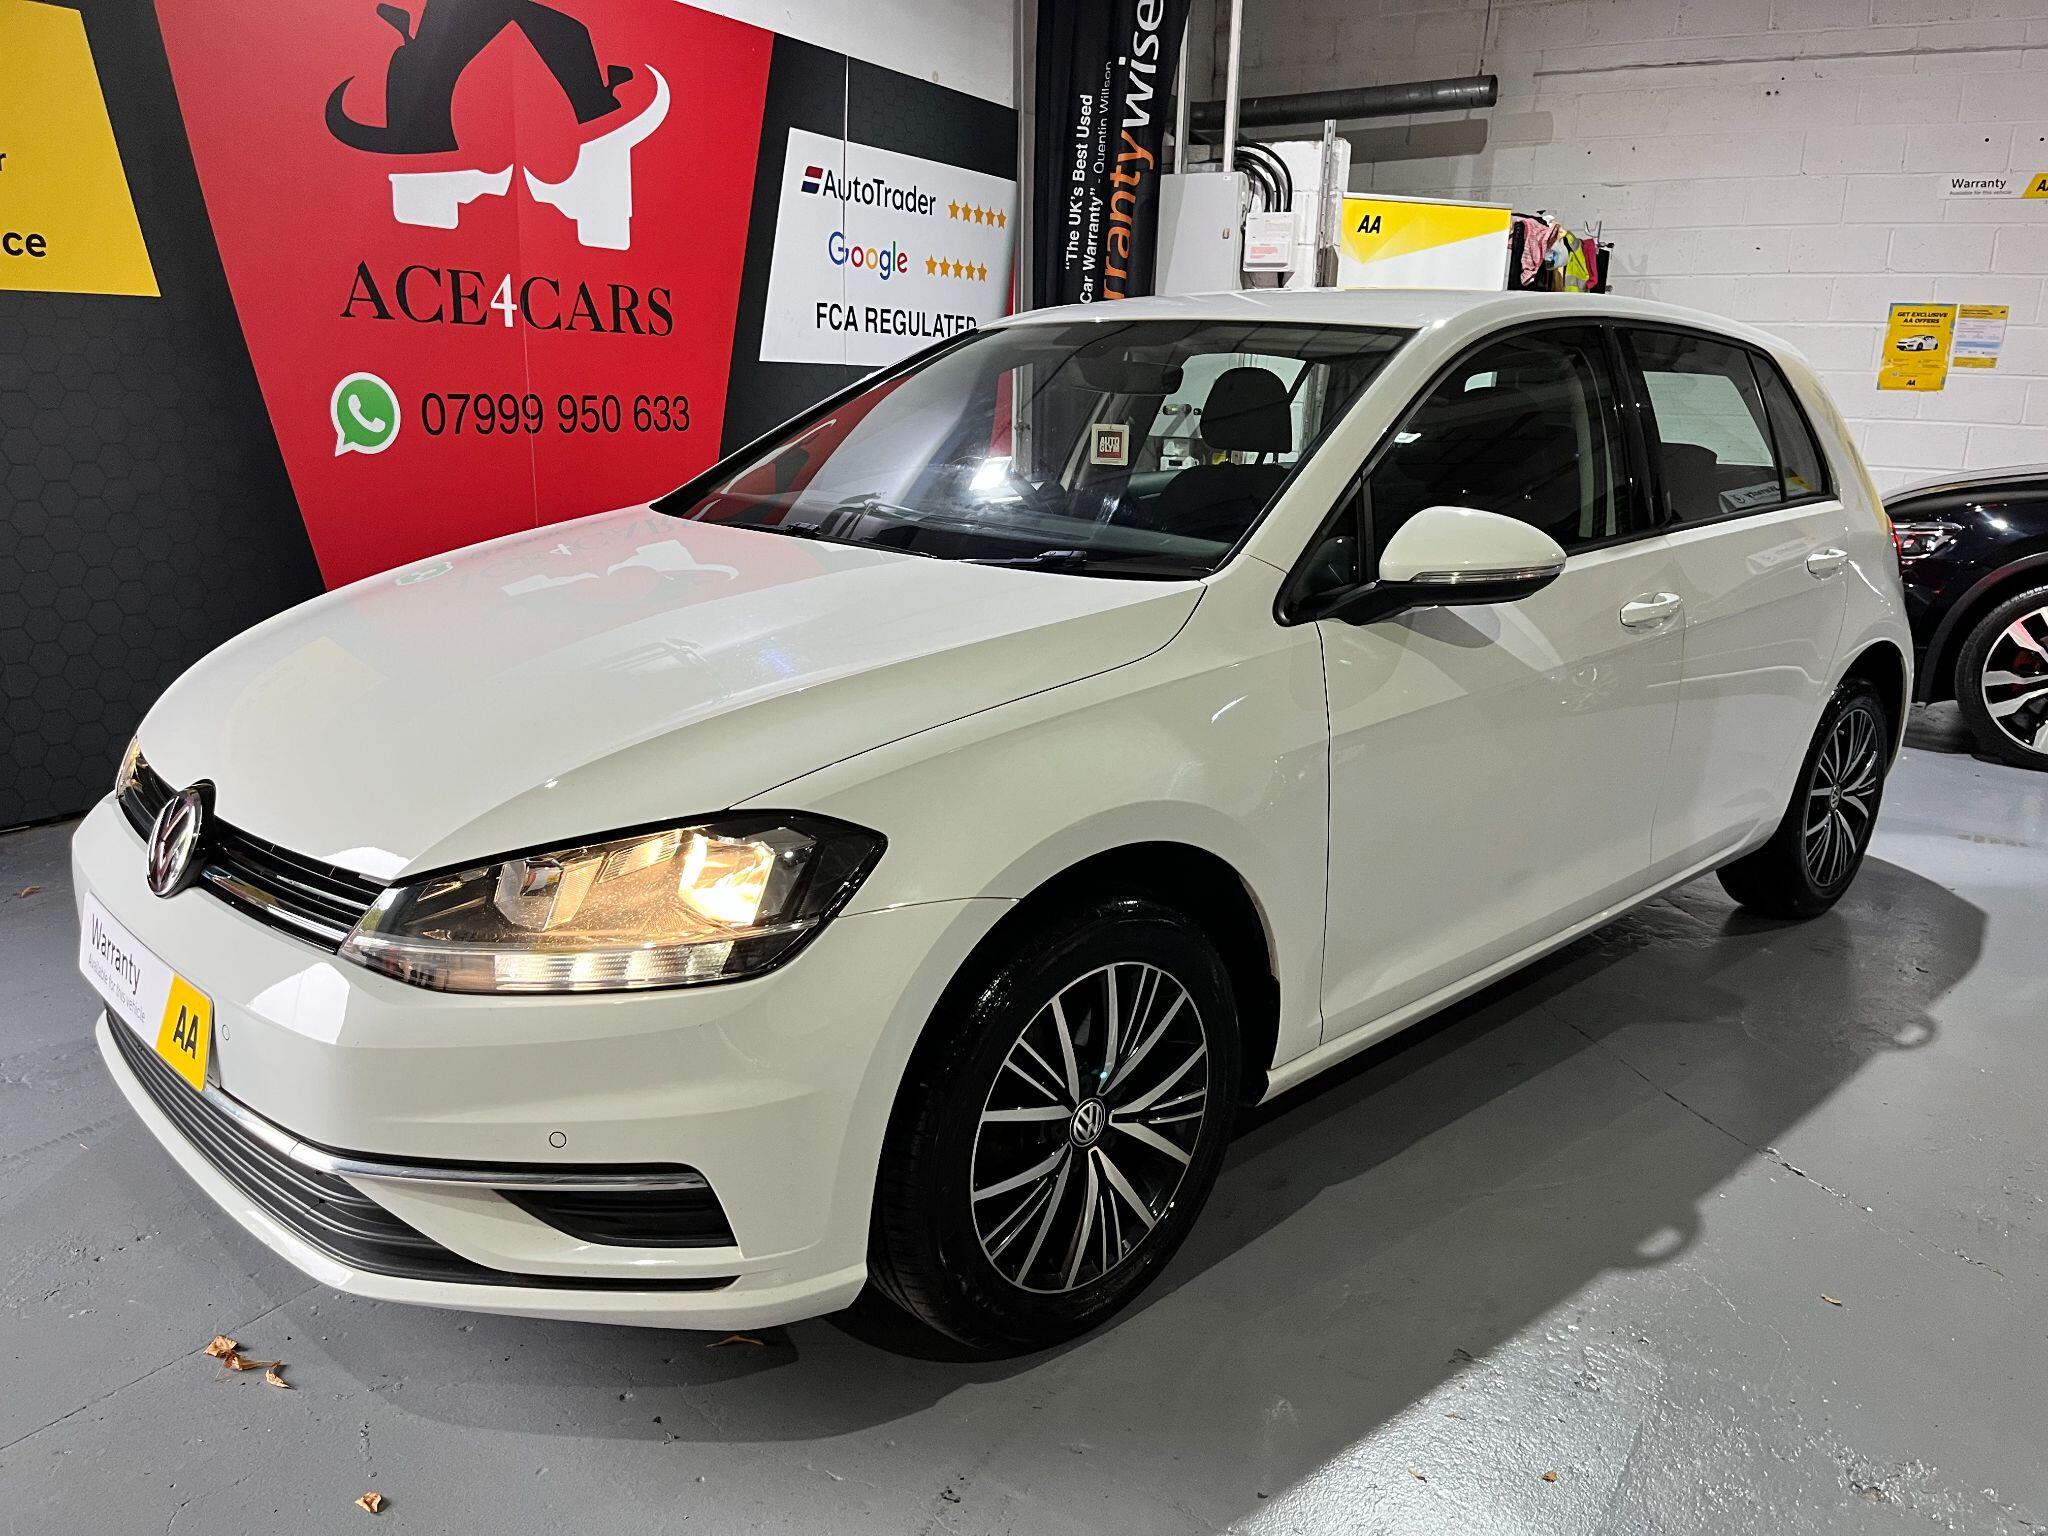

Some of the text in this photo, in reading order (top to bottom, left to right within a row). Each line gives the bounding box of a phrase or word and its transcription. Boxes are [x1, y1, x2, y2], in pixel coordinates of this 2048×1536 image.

[1099, 61, 1111, 114] Willson
[1076, 94, 1093, 138] Used
[1072, 143, 1088, 182] Best
[1094, 118, 1107, 174] Quentin
[823, 169, 937, 216] AutoTrader
[1951, 178, 2007, 190] Warranty
[1068, 187, 1084, 226] UK’s
[1357, 214, 1382, 234] AA
[828, 231, 908, 281] Google
[340, 260, 674, 337] ACE4CARS
[1080, 275, 1094, 304] Car
[816, 302, 859, 332] FCA
[421, 393, 690, 436] 07999 950 633
[91, 913, 141, 995] Warranty
[126, 998, 146, 1024] vehicle
[172, 1004, 199, 1060] AA
